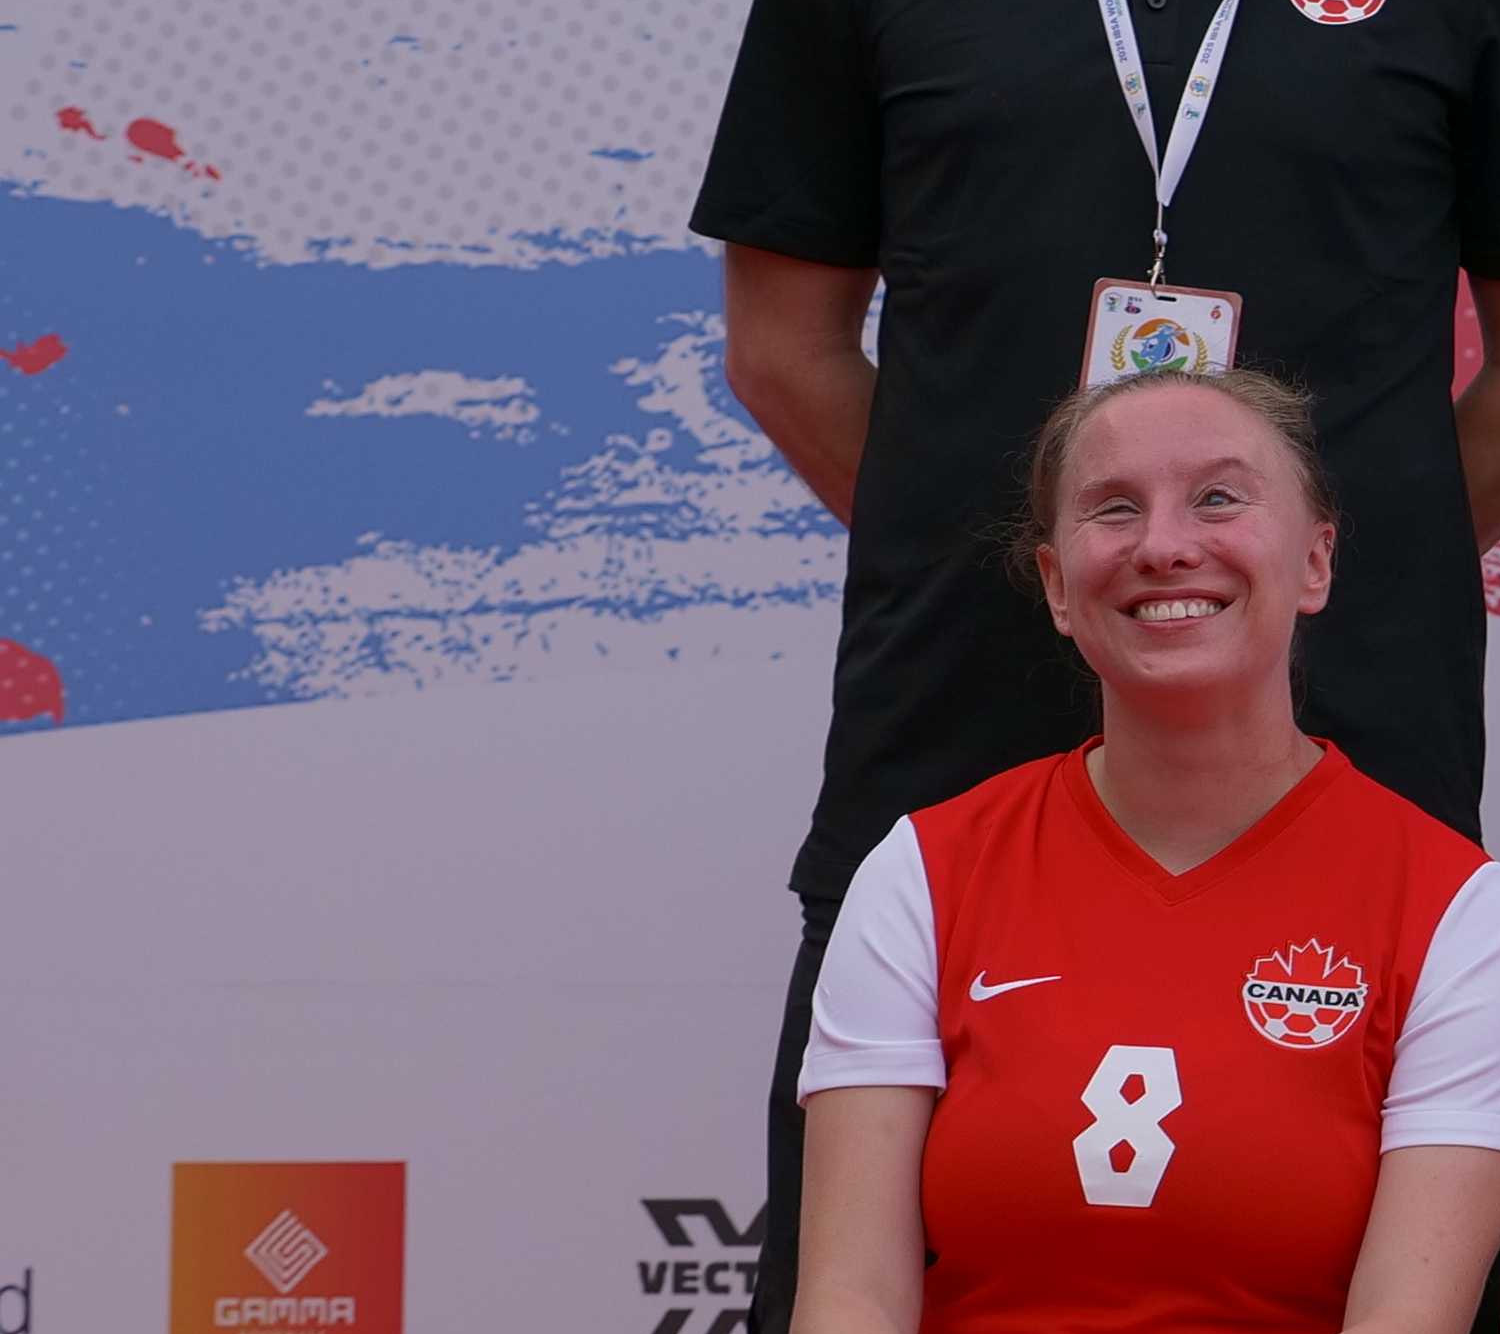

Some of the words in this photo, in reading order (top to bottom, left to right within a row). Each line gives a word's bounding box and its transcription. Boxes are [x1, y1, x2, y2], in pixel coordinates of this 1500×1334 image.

[1247, 982, 1360, 1008] CANADA
[1072, 1044, 1183, 1208] 8
[214, 1296, 356, 1327] GAMMA
